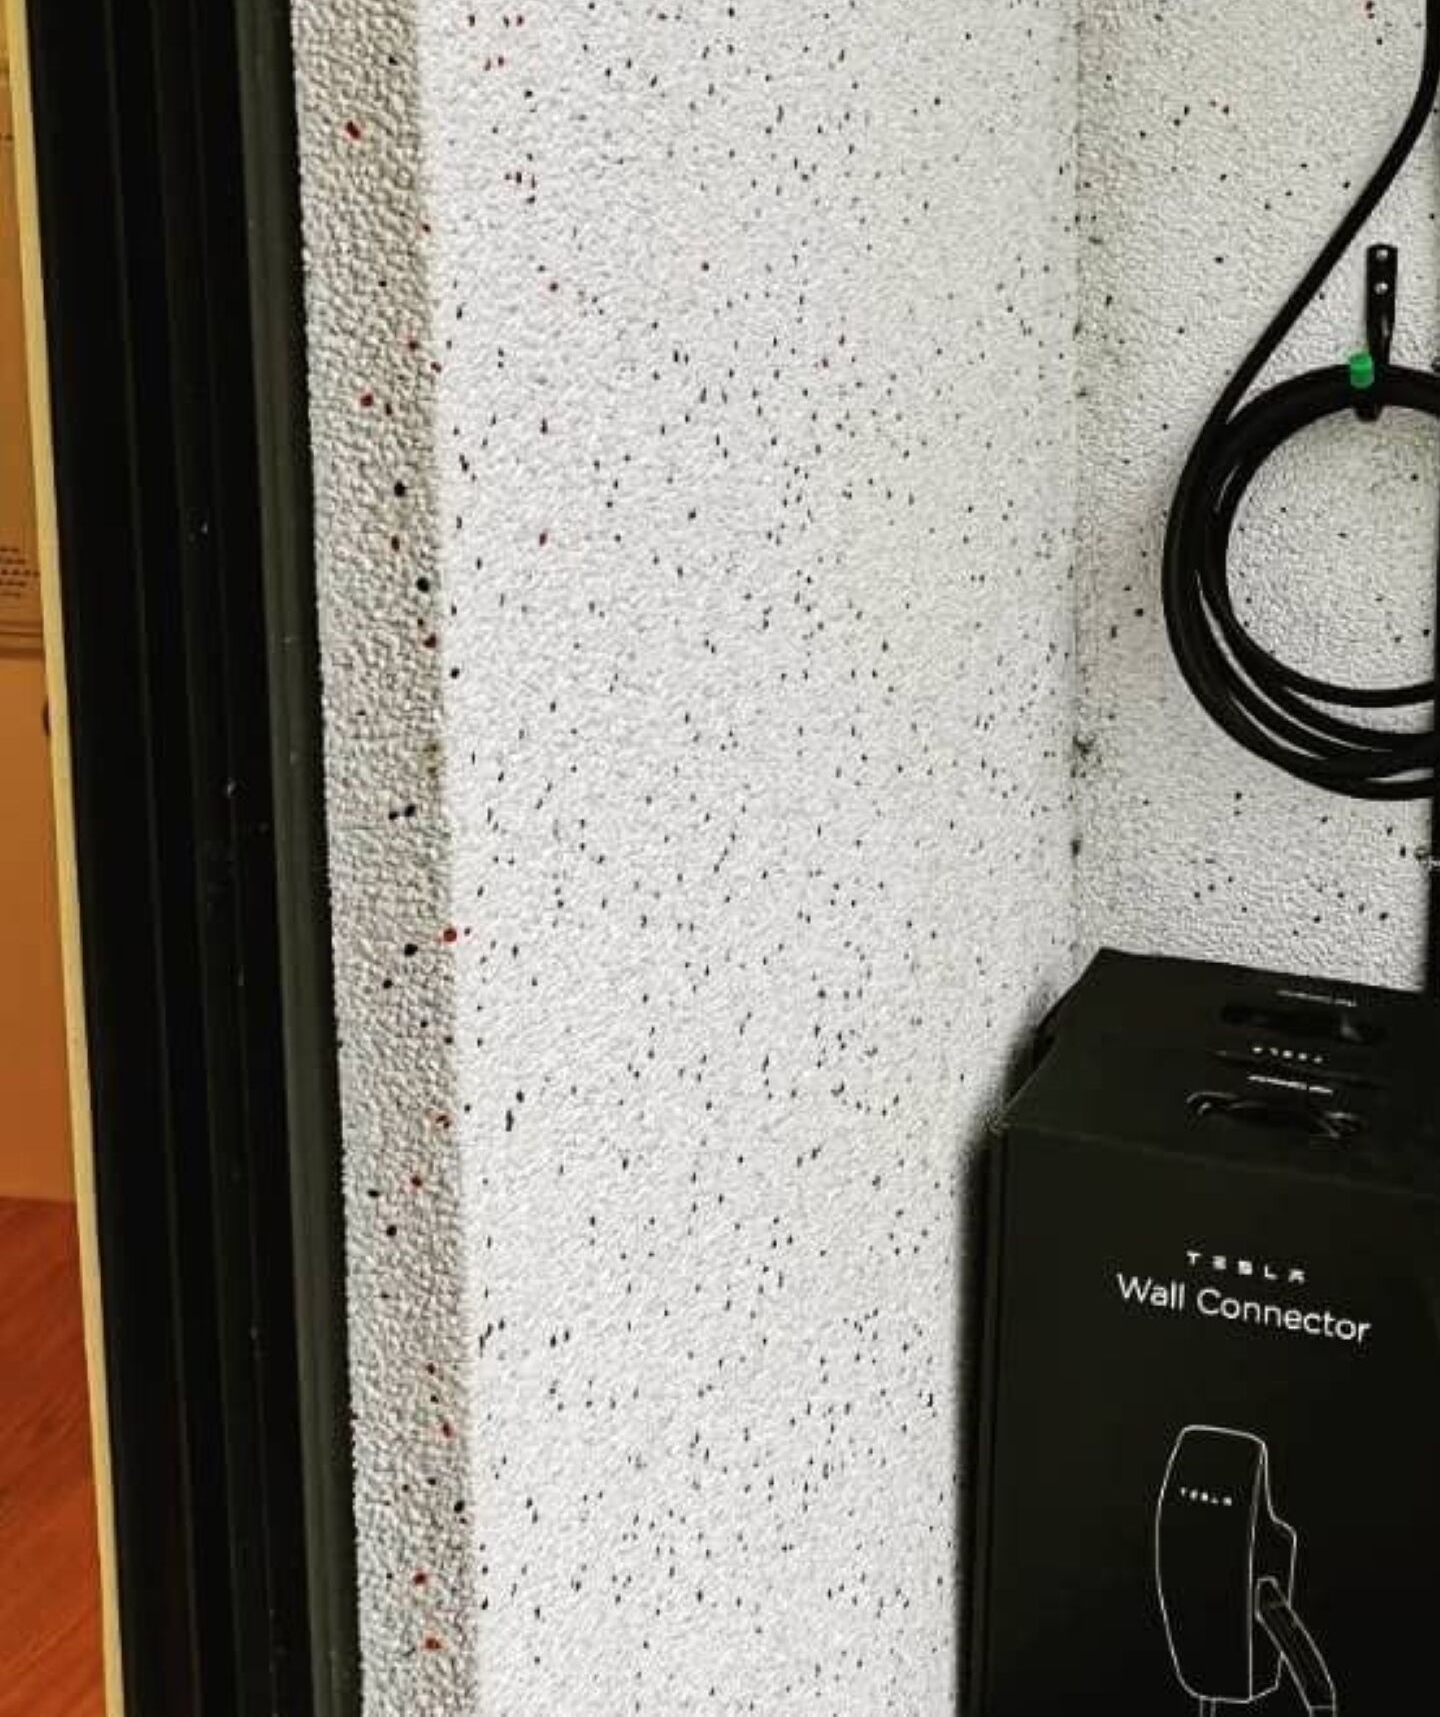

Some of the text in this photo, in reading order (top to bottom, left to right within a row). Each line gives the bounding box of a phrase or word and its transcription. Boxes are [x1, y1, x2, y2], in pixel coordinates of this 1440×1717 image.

[1186, 1249, 1306, 1284] TESLA
[1116, 1272, 1372, 1343] Wall Connector
